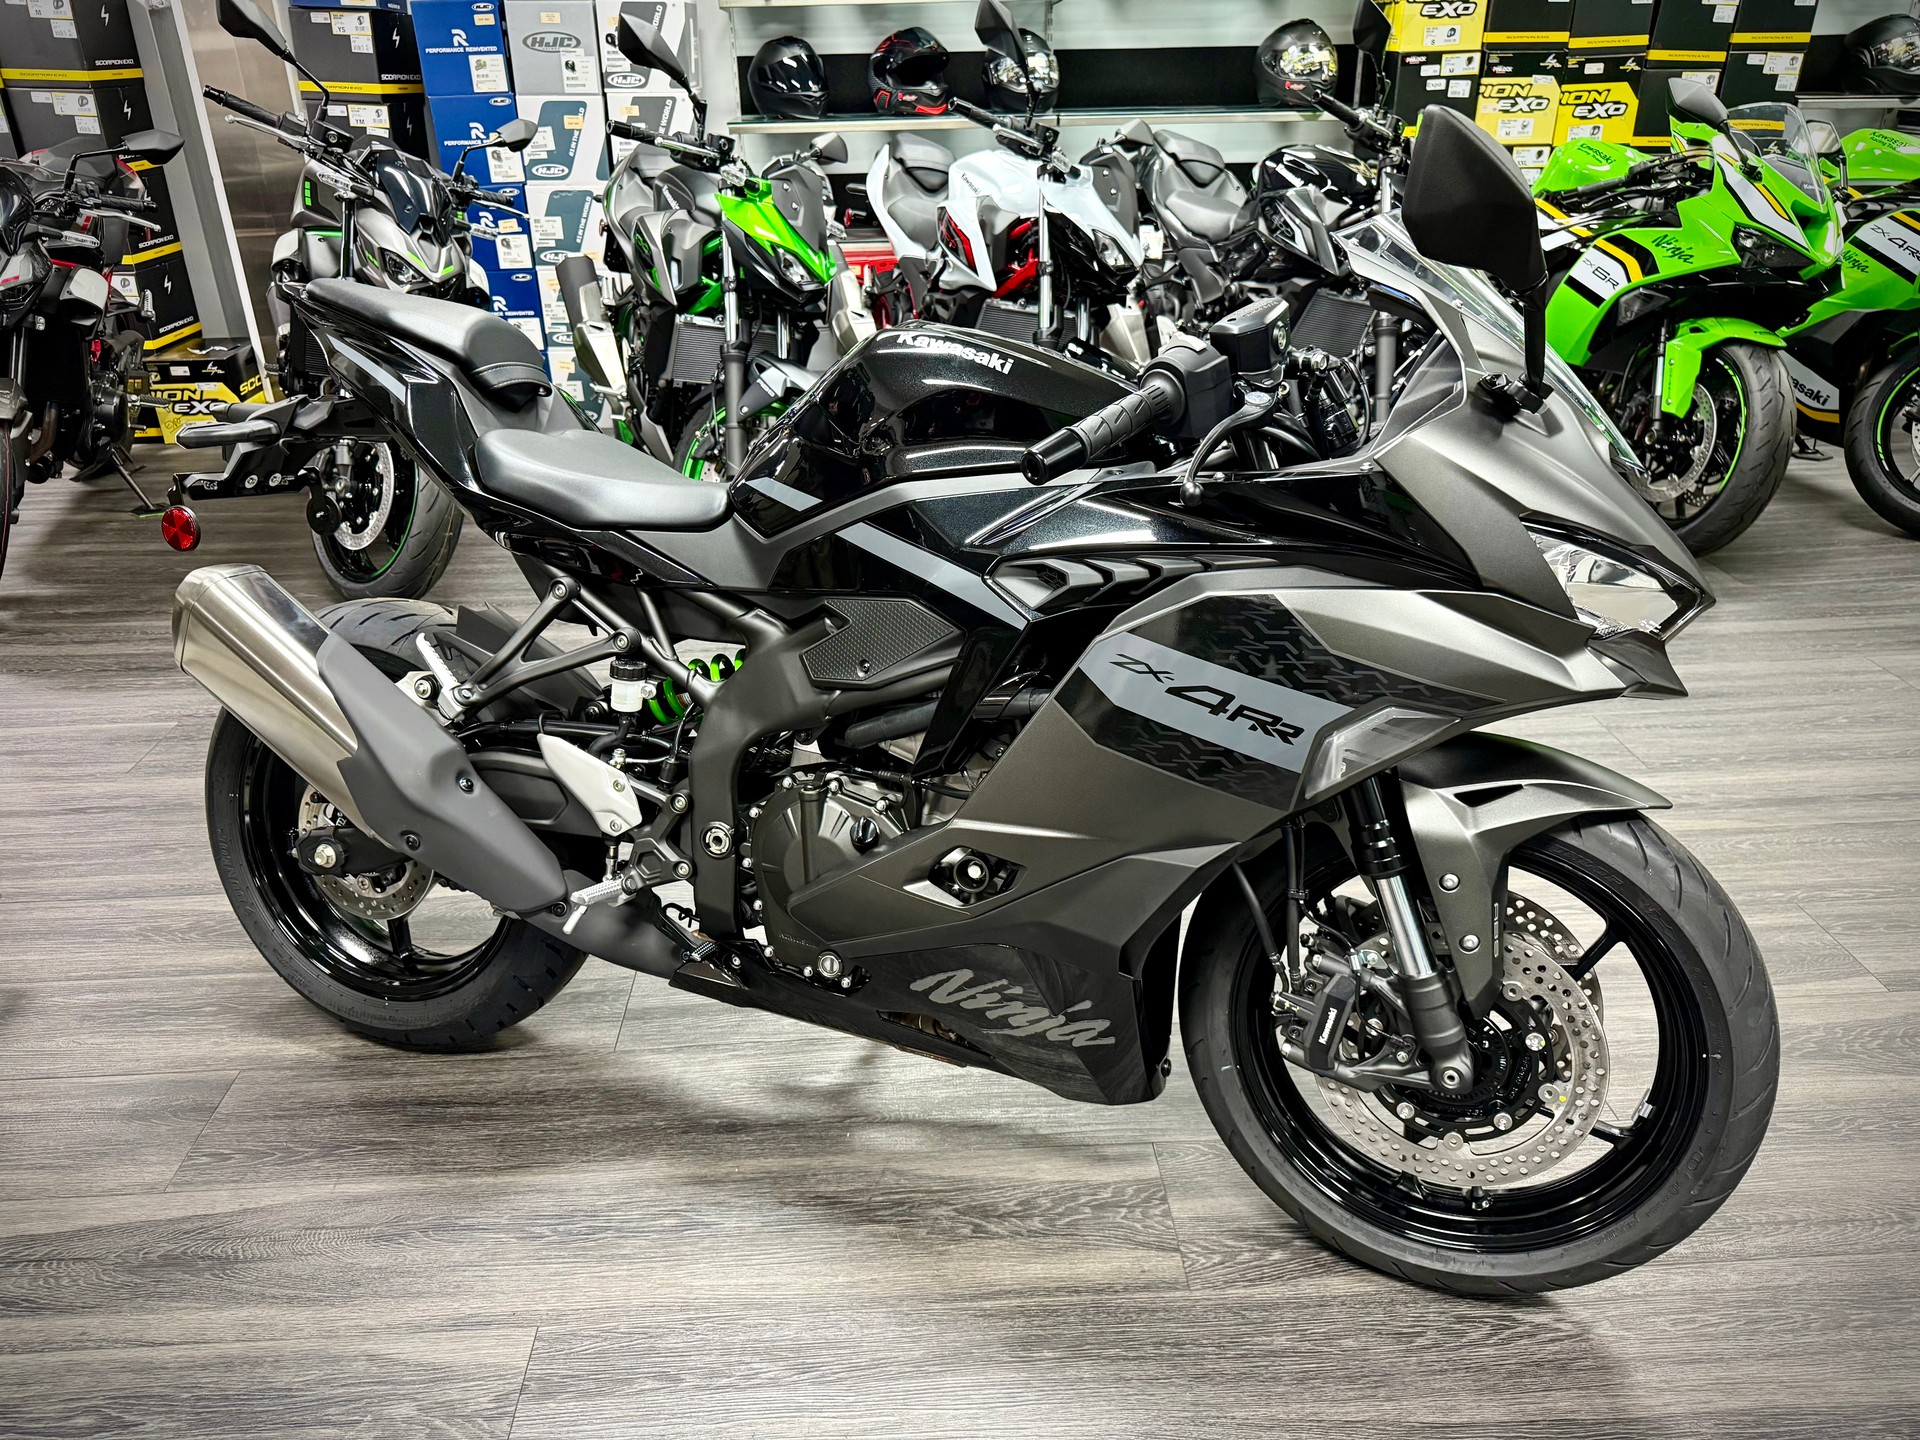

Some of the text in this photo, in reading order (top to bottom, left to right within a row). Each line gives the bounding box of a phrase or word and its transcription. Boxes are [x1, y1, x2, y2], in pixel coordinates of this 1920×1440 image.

[652, 5, 663, 28] ORLD
[1421, 1, 1476, 18] EXO
[530, 37, 573, 48] HJC
[612, 76, 641, 84] HJC
[1496, 97, 1550, 112] EXO
[1560, 90, 1611, 104] ION
[660, 99, 673, 127] WORLD
[1573, 102, 1628, 118] EXO
[961, 172, 981, 195] Kawasaki
[581, 196, 592, 218] WORLD
[578, 217, 587, 229] THE
[138, 237, 164, 249] SCORPION
[1651, 234, 1694, 264] Ninja
[159, 320, 184, 333] SCORPION
[896, 333, 1015, 375] Kawasaki
[151, 389, 202, 401] ION
[1791, 376, 1831, 406] asaki
[1109, 653, 1305, 746] ZX-4RR
[909, 968, 1116, 1048] Ninja
[1318, 1007, 1338, 1045] Kawasaki
